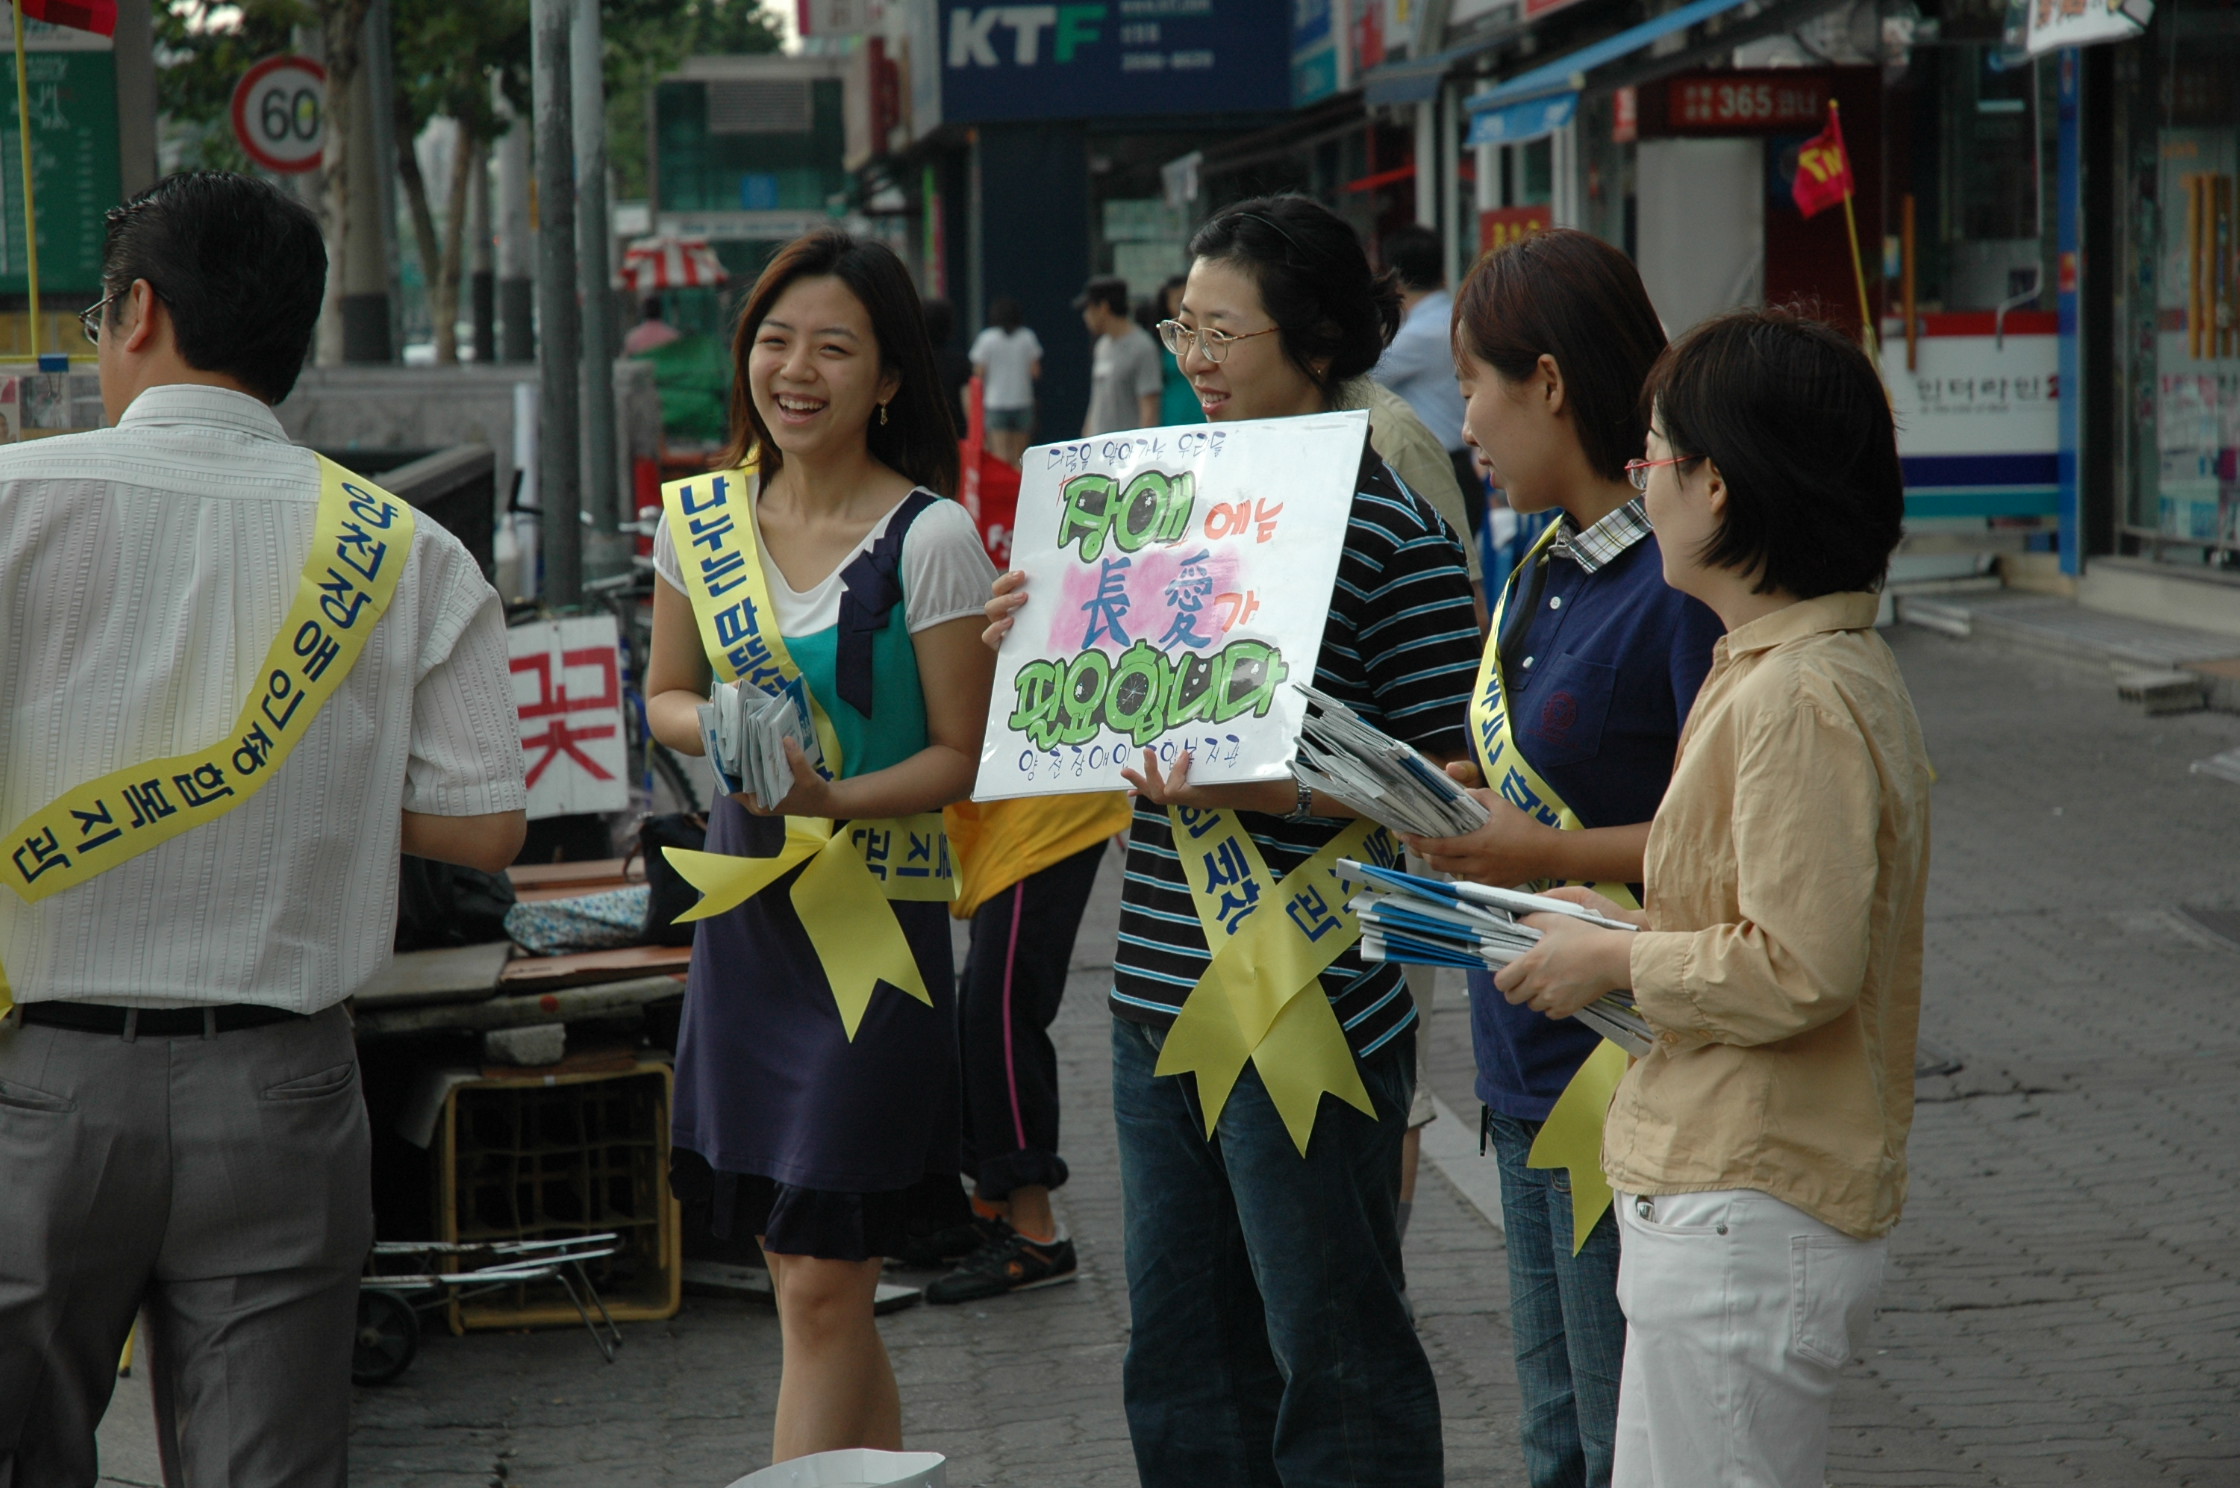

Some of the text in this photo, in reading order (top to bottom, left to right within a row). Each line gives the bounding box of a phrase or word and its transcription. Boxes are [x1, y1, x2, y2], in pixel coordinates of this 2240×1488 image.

[948, 4, 1108, 68] KTF
[261, 88, 319, 143] 60
[1719, 85, 1772, 117] 365
[1048, 442, 1091, 472] 다름을
[1178, 430, 1226, 458] 우리들
[679, 475, 748, 598] 나누는
[1008, 638, 1289, 754] 필요합니다
